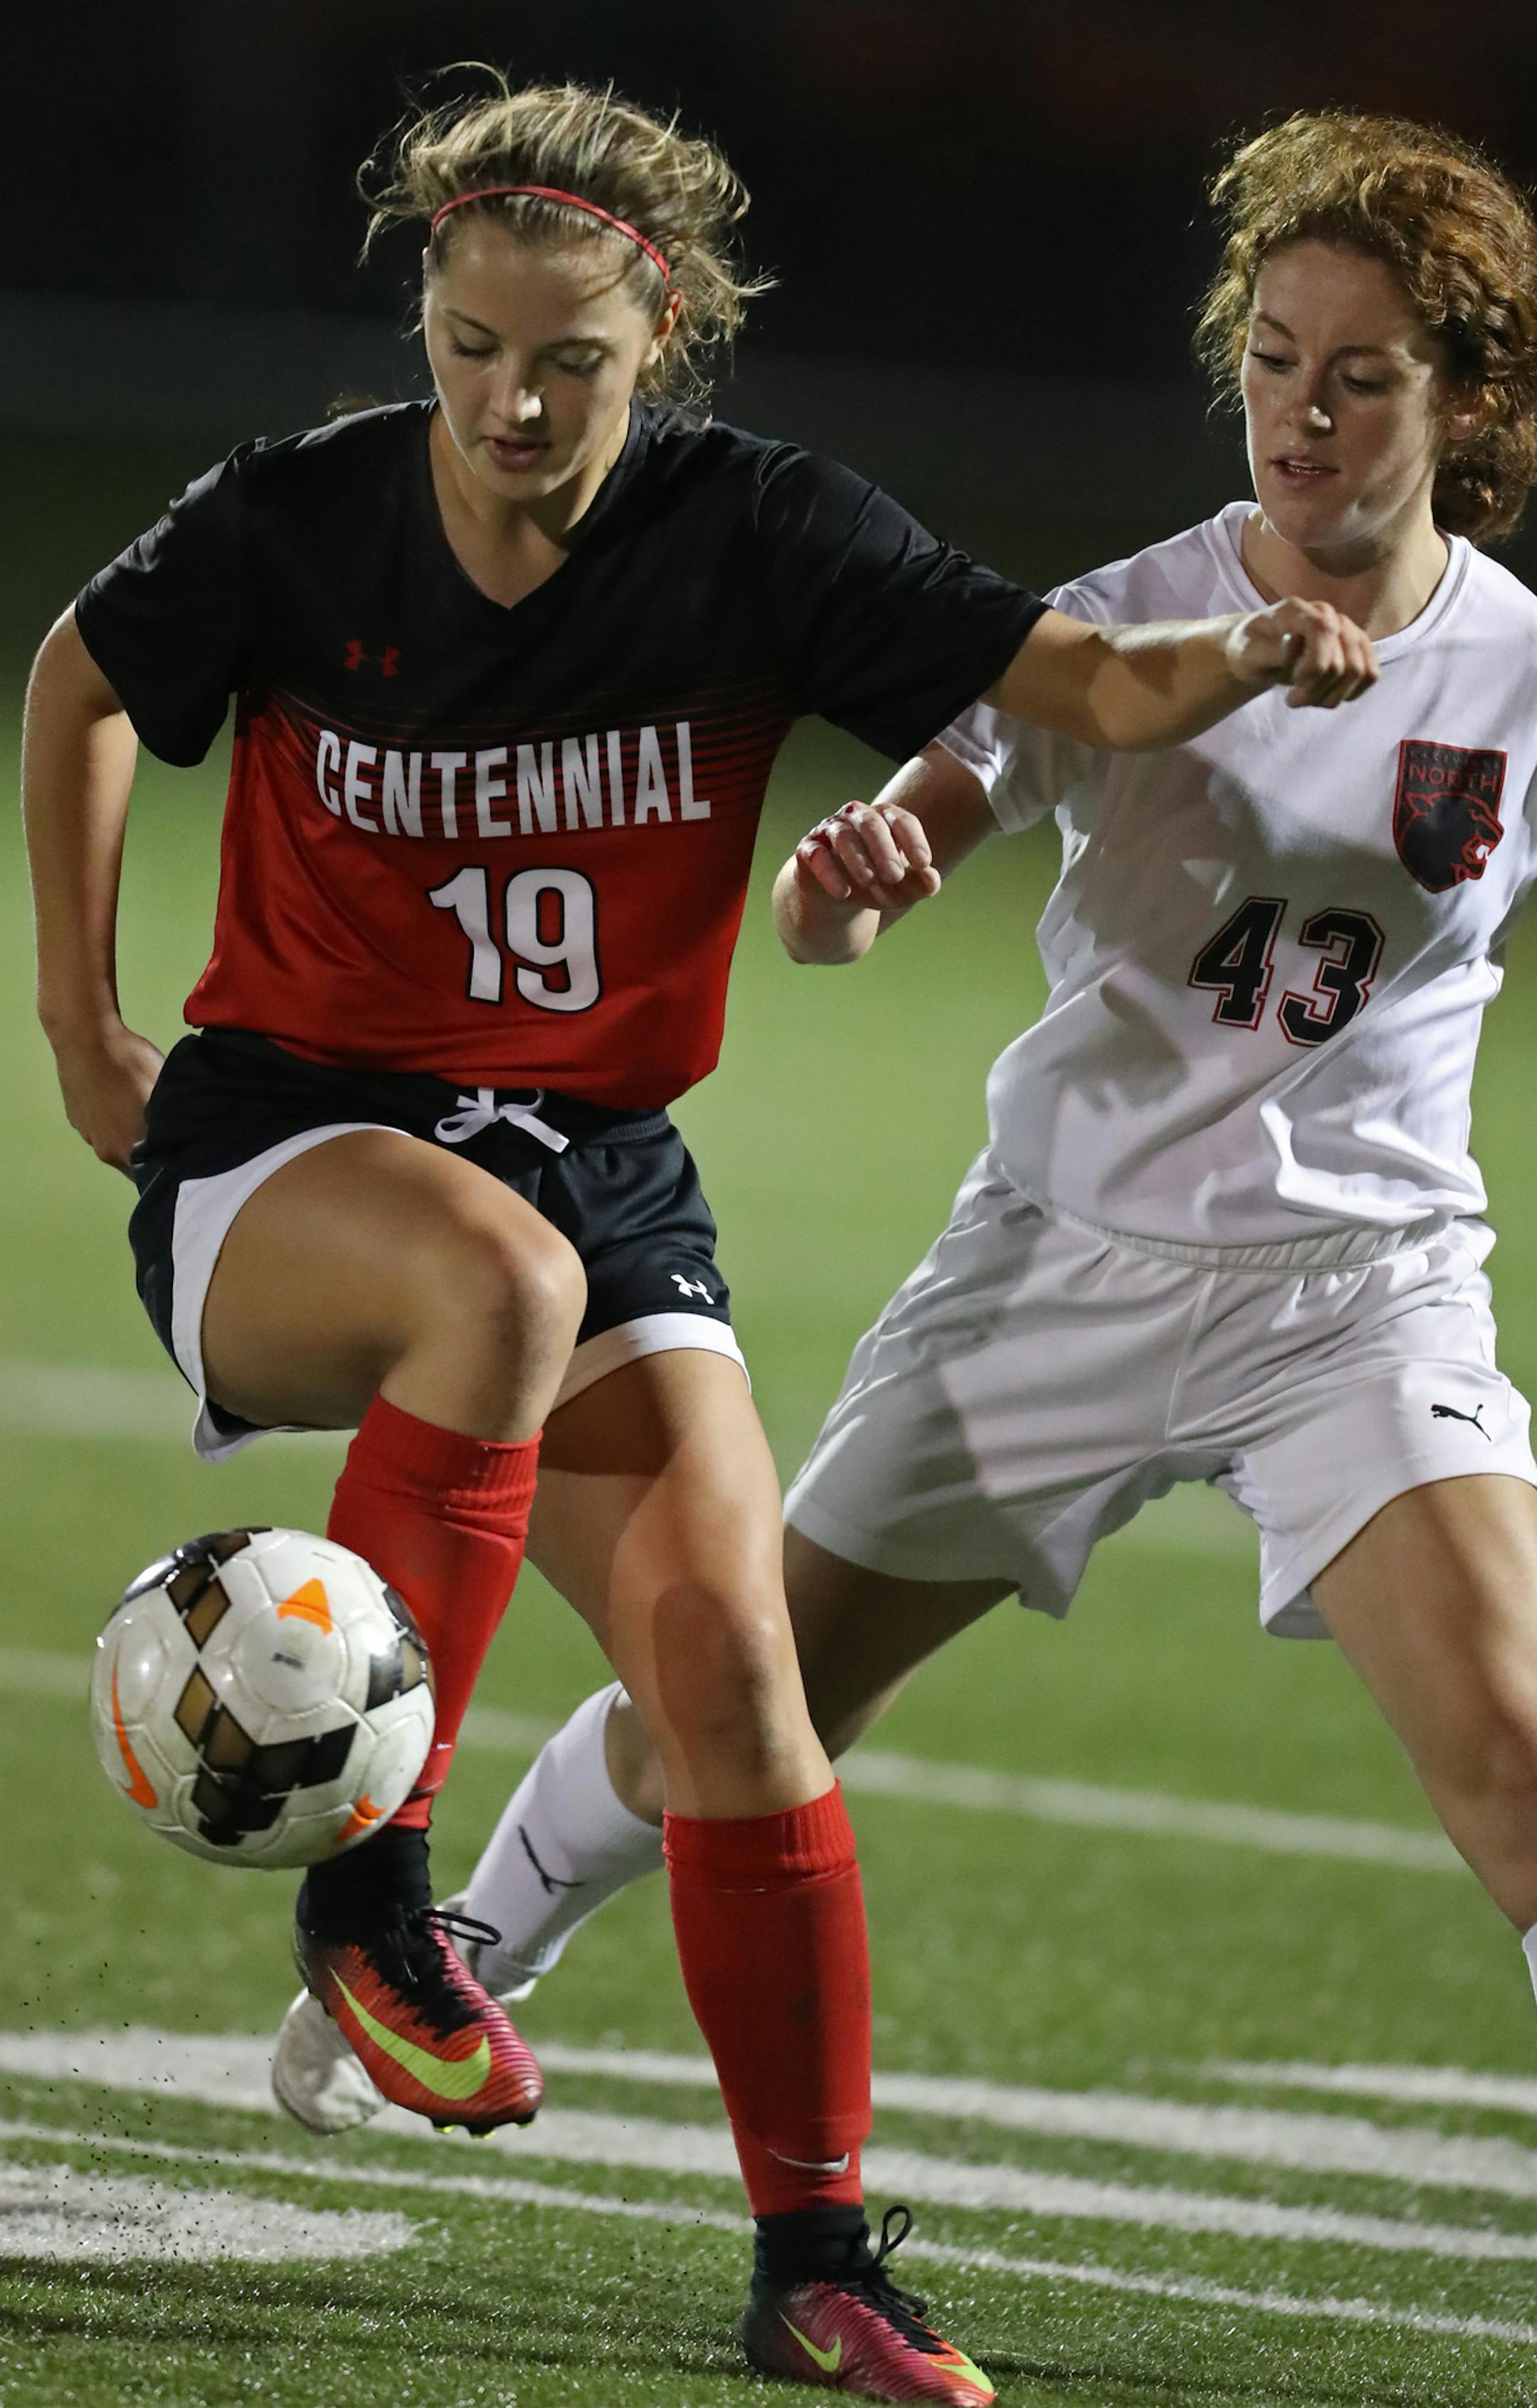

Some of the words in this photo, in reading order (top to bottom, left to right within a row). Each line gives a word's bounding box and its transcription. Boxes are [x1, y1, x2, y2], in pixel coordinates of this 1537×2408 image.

[316, 721, 712, 839] CENTENNIAL
[428, 866, 601, 1016] 19
[1187, 895, 1386, 1048] 43
